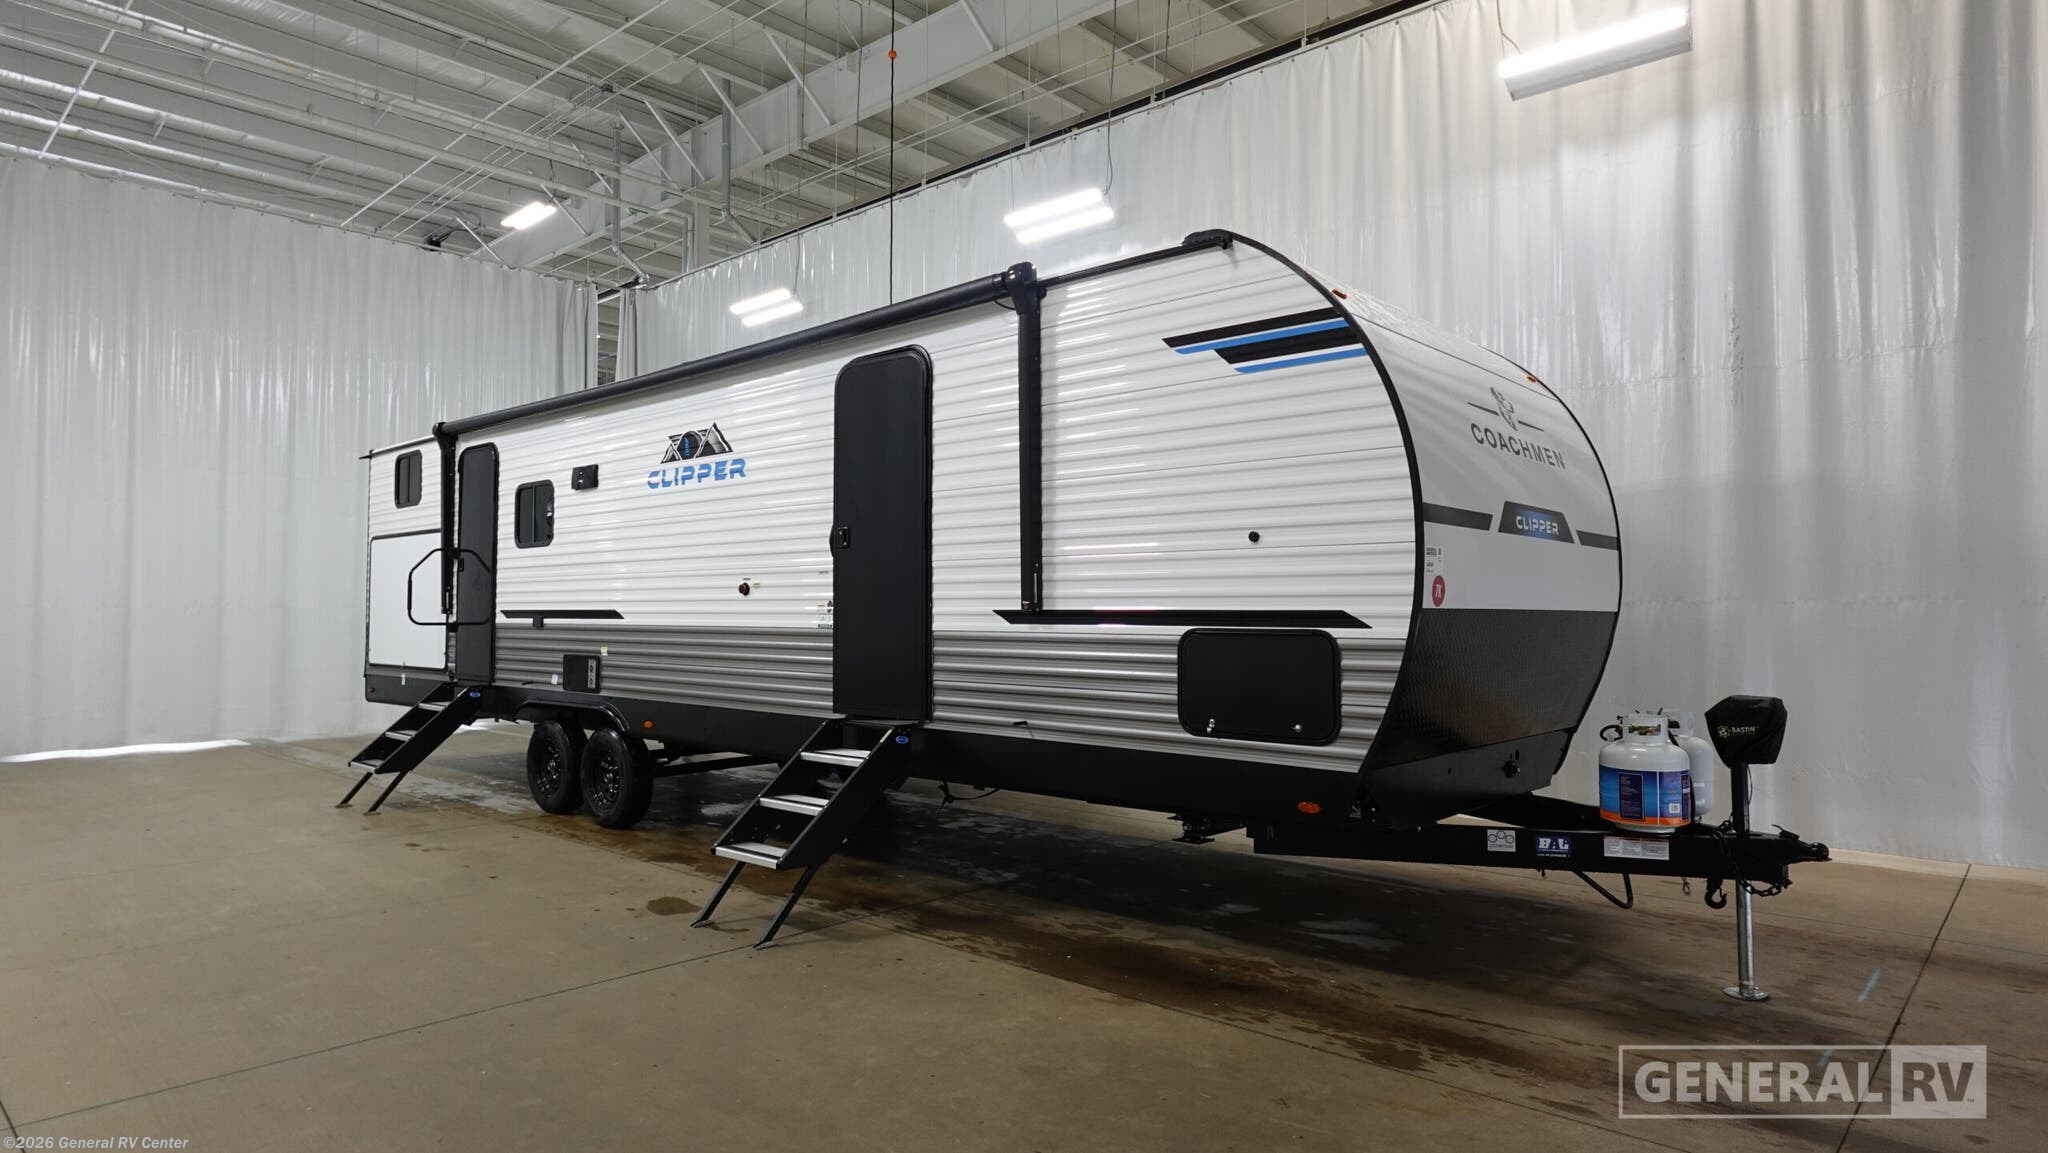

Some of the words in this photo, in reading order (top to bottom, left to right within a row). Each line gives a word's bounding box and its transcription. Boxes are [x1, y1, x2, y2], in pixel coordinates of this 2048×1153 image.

[1470, 423, 1565, 469] COACHMEN
[647, 458, 747, 489] CLIPPER
[1515, 515, 1559, 535] CLIPPER
